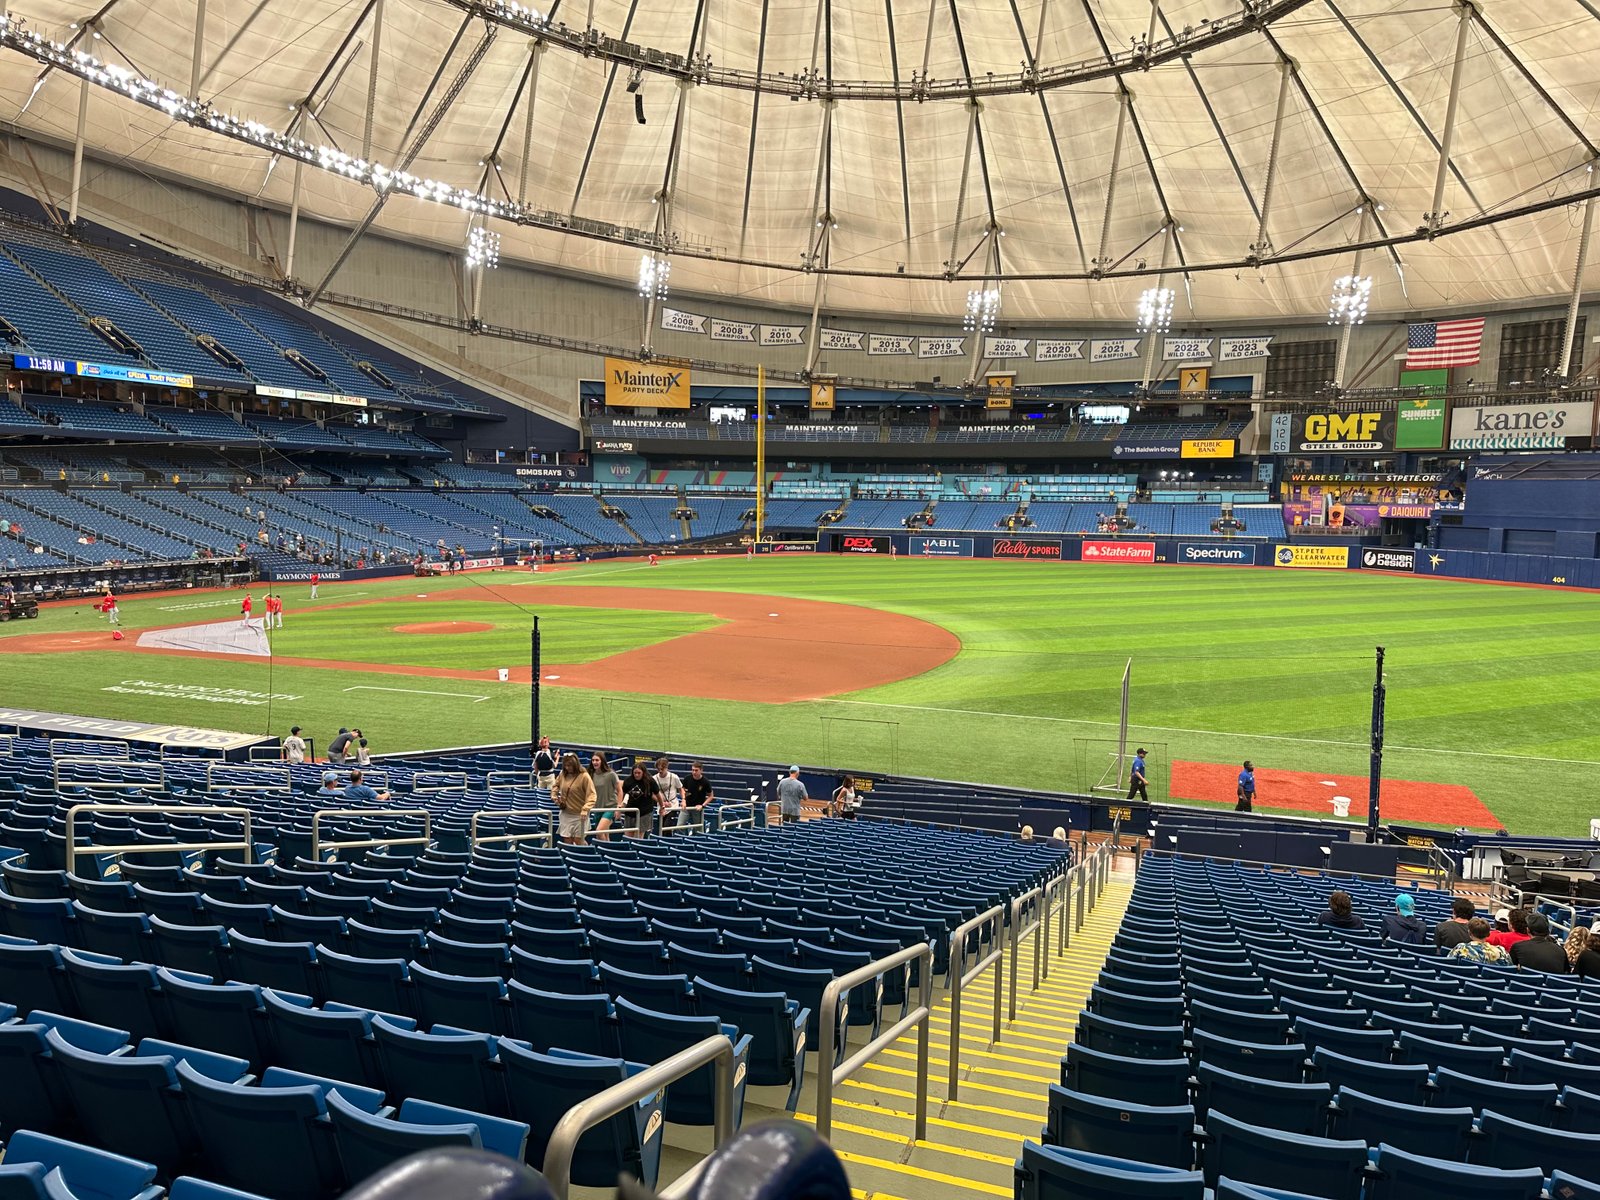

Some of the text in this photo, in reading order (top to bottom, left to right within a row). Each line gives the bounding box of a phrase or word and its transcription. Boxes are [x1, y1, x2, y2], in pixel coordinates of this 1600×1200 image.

[672, 316, 694, 326] 2008
[666, 322, 699, 332] CHAMPIONS
[720, 326, 743, 335] 2008
[714, 332, 749, 340] CHAMPIONS
[1046, 346, 1071, 354] 2020
[1101, 345, 1125, 353] 2021
[1231, 344, 1257, 352] 2023
[1094, 352, 1133, 360] CHAMPIONS
[29, 357, 65, 372] 11:58 AM
[614, 370, 682, 393] MaintenX
[612, 419, 686, 428] MAINTENX.COM
[1275, 416, 1288, 426] 42
[1474, 408, 1567, 431] kane's
[785, 425, 858, 433] MAINTENX.COM
[1304, 412, 1381, 441] GMF
[1276, 429, 1286, 439] 12
[1160, 446, 1179, 454] Group
[1274, 442, 1286, 451] 66
[1386, 474, 1442, 482] STPETE.ORG
[1391, 507, 1425, 517] DAIQUIRI
[843, 538, 874, 547] DEX
[922, 539, 960, 548] JABIL
[993, 540, 1060, 558] Bally SPORTS
[1186, 547, 1242, 560] Spectrum
[1552, 576, 1565, 584] 404
[39, 717, 142, 732] FIELD
